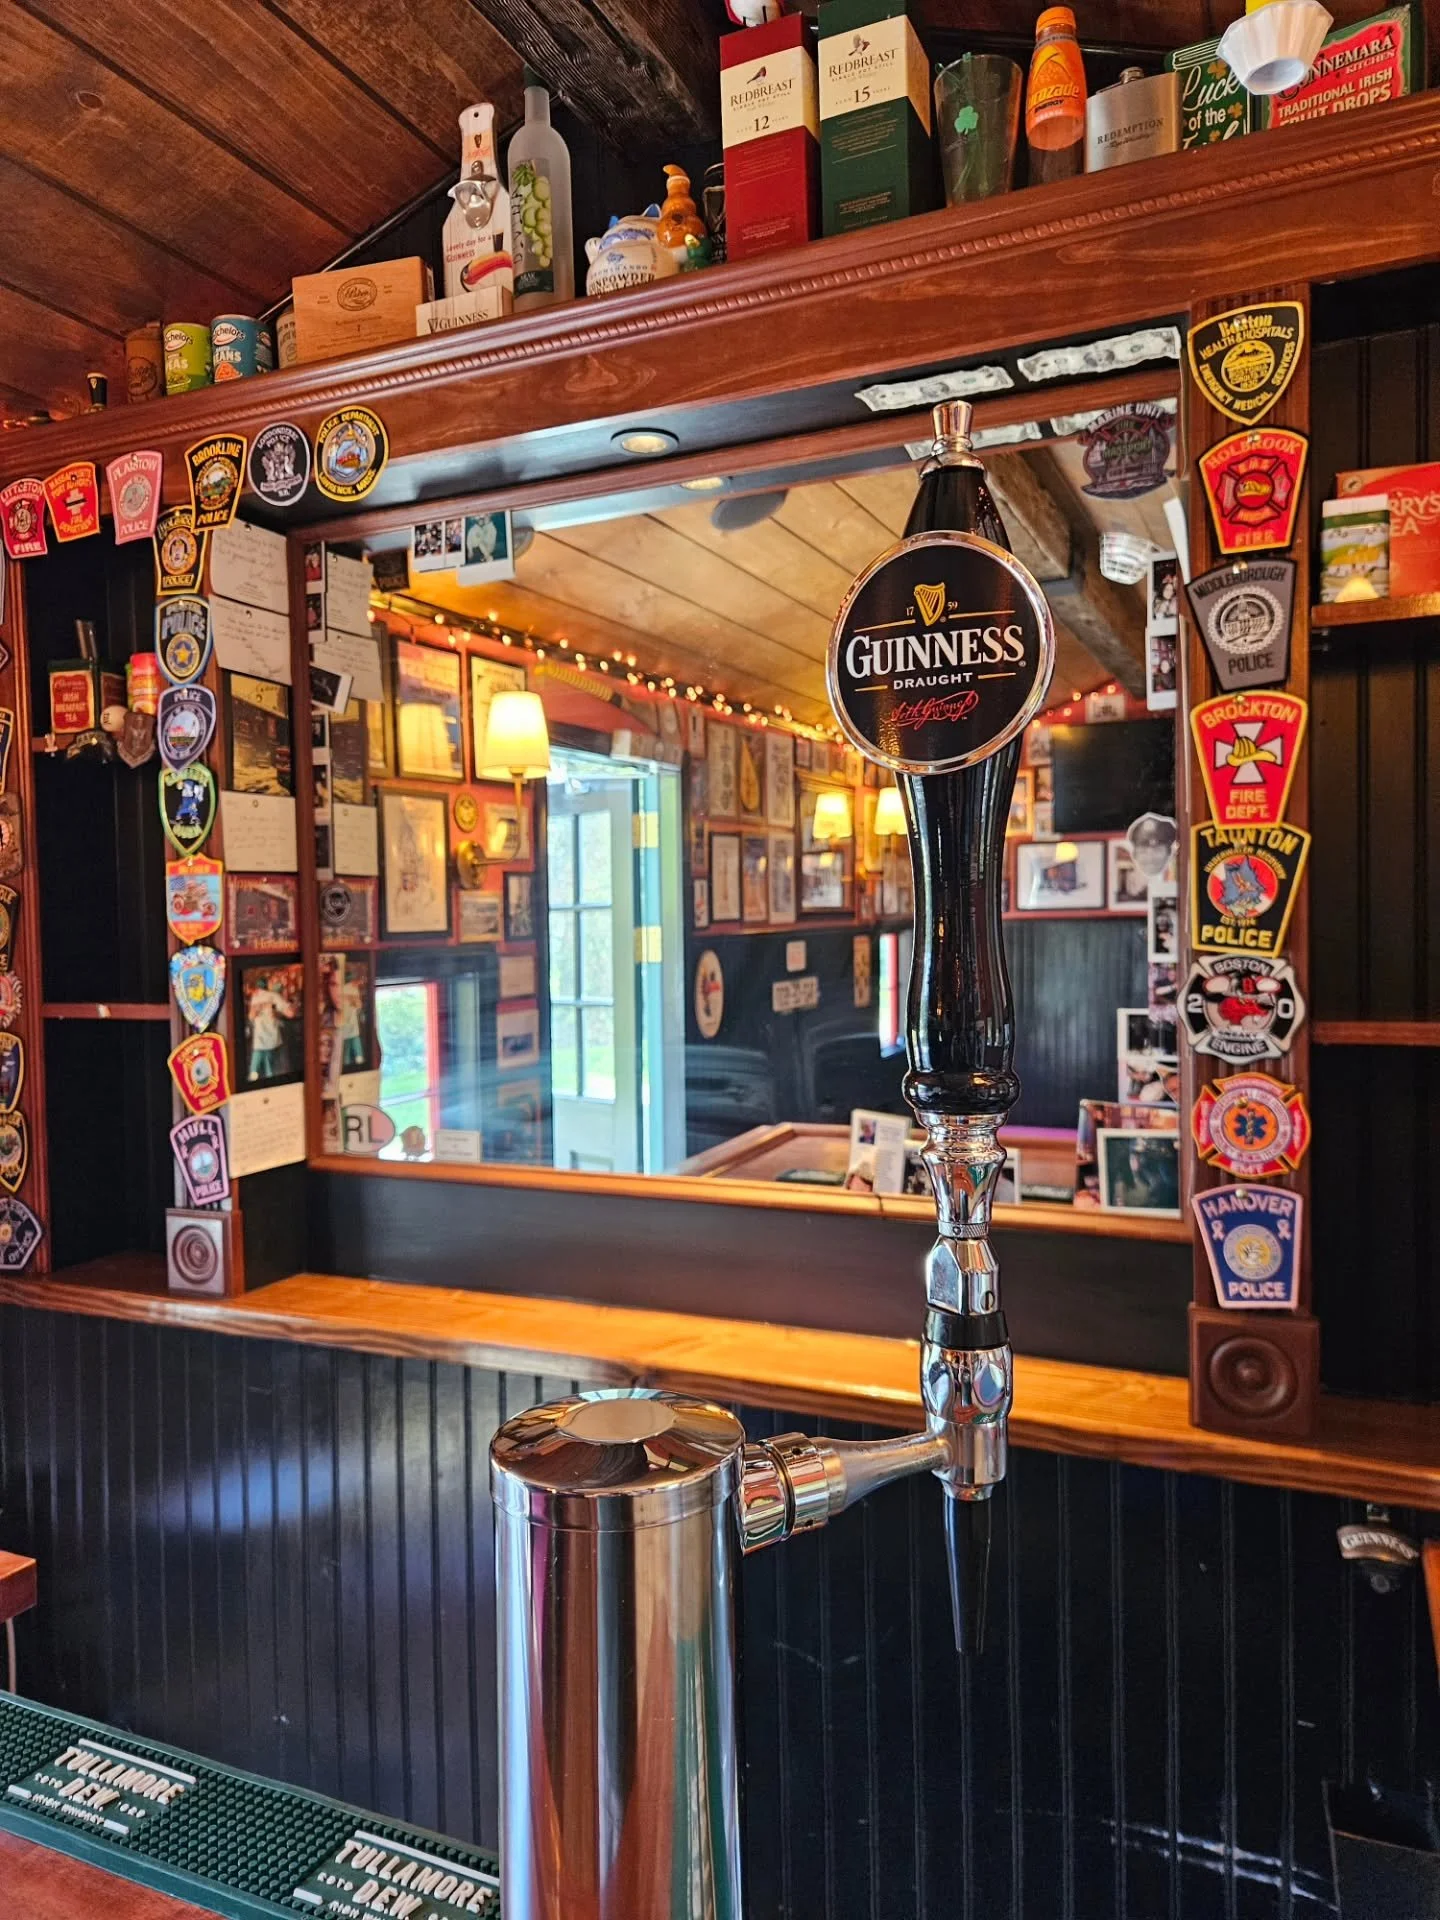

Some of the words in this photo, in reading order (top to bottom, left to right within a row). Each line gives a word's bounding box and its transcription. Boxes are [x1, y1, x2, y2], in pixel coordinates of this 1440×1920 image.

[828, 47, 898, 78] REDBREAST
[1345, 51, 1395, 74] KITCHEN
[730, 77, 795, 107] REDBREAST
[854, 85, 871, 104] 15
[1182, 65, 1241, 111] Luck
[1278, 80, 1356, 119] TRADITIONAL
[1359, 67, 1393, 89] IRISH
[754, 115, 770, 132] 12
[1097, 117, 1164, 145] REDEMPTION
[1188, 110, 1202, 131] of
[1205, 106, 1227, 126] the
[446, 249, 476, 263] GUINNESS
[440, 309, 489, 330] GUINNESS
[1199, 335, 1236, 360] HEALTH
[1243, 326, 1295, 340] HOSPITALS
[1271, 341, 1296, 386] SERVICES
[320, 417, 340, 443] POLICE
[341, 410, 380, 437] DEPARTMENT
[1087, 403, 1133, 435] MARINE
[1135, 403, 1165, 420] UNIT
[191, 441, 242, 467] BROOKLINE
[1205, 436, 1300, 470] HOLBROOK
[0, 482, 44, 501] LITTLETON
[1389, 490, 1440, 518] RRY'S
[120, 519, 149, 536] POLICE
[197, 509, 230, 525] POLICE
[1390, 516, 1420, 537] EA
[13, 541, 43, 555] FIRE
[1235, 529, 1275, 546] FIRE
[906, 606, 915, 617] 17
[947, 601, 958, 611] 59
[845, 625, 1024, 679] GUINNESS
[1228, 652, 1275, 675] POLICE
[893, 672, 973, 690] DRAUGHT
[1201, 700, 1298, 729] BROCKTON
[1229, 789, 1267, 804] FIRE
[1225, 804, 1270, 820] DEPT.
[1200, 827, 1300, 857] TAUNTON
[1201, 924, 1273, 949] POLICE
[1214, 958, 1271, 977] BOSTON
[1187, 993, 1203, 1014] 2
[1277, 997, 1294, 1019] 0
[1210, 1040, 1265, 1056] ENGINE
[176, 1120, 216, 1145] HULL
[344, 1113, 385, 1144] RL
[1201, 1194, 1294, 1219] HANOVER
[1228, 1281, 1287, 1300] POLICE
[54, 1745, 186, 1806] TULLAMORE
[335, 1838, 493, 1914] TULLAMORE
